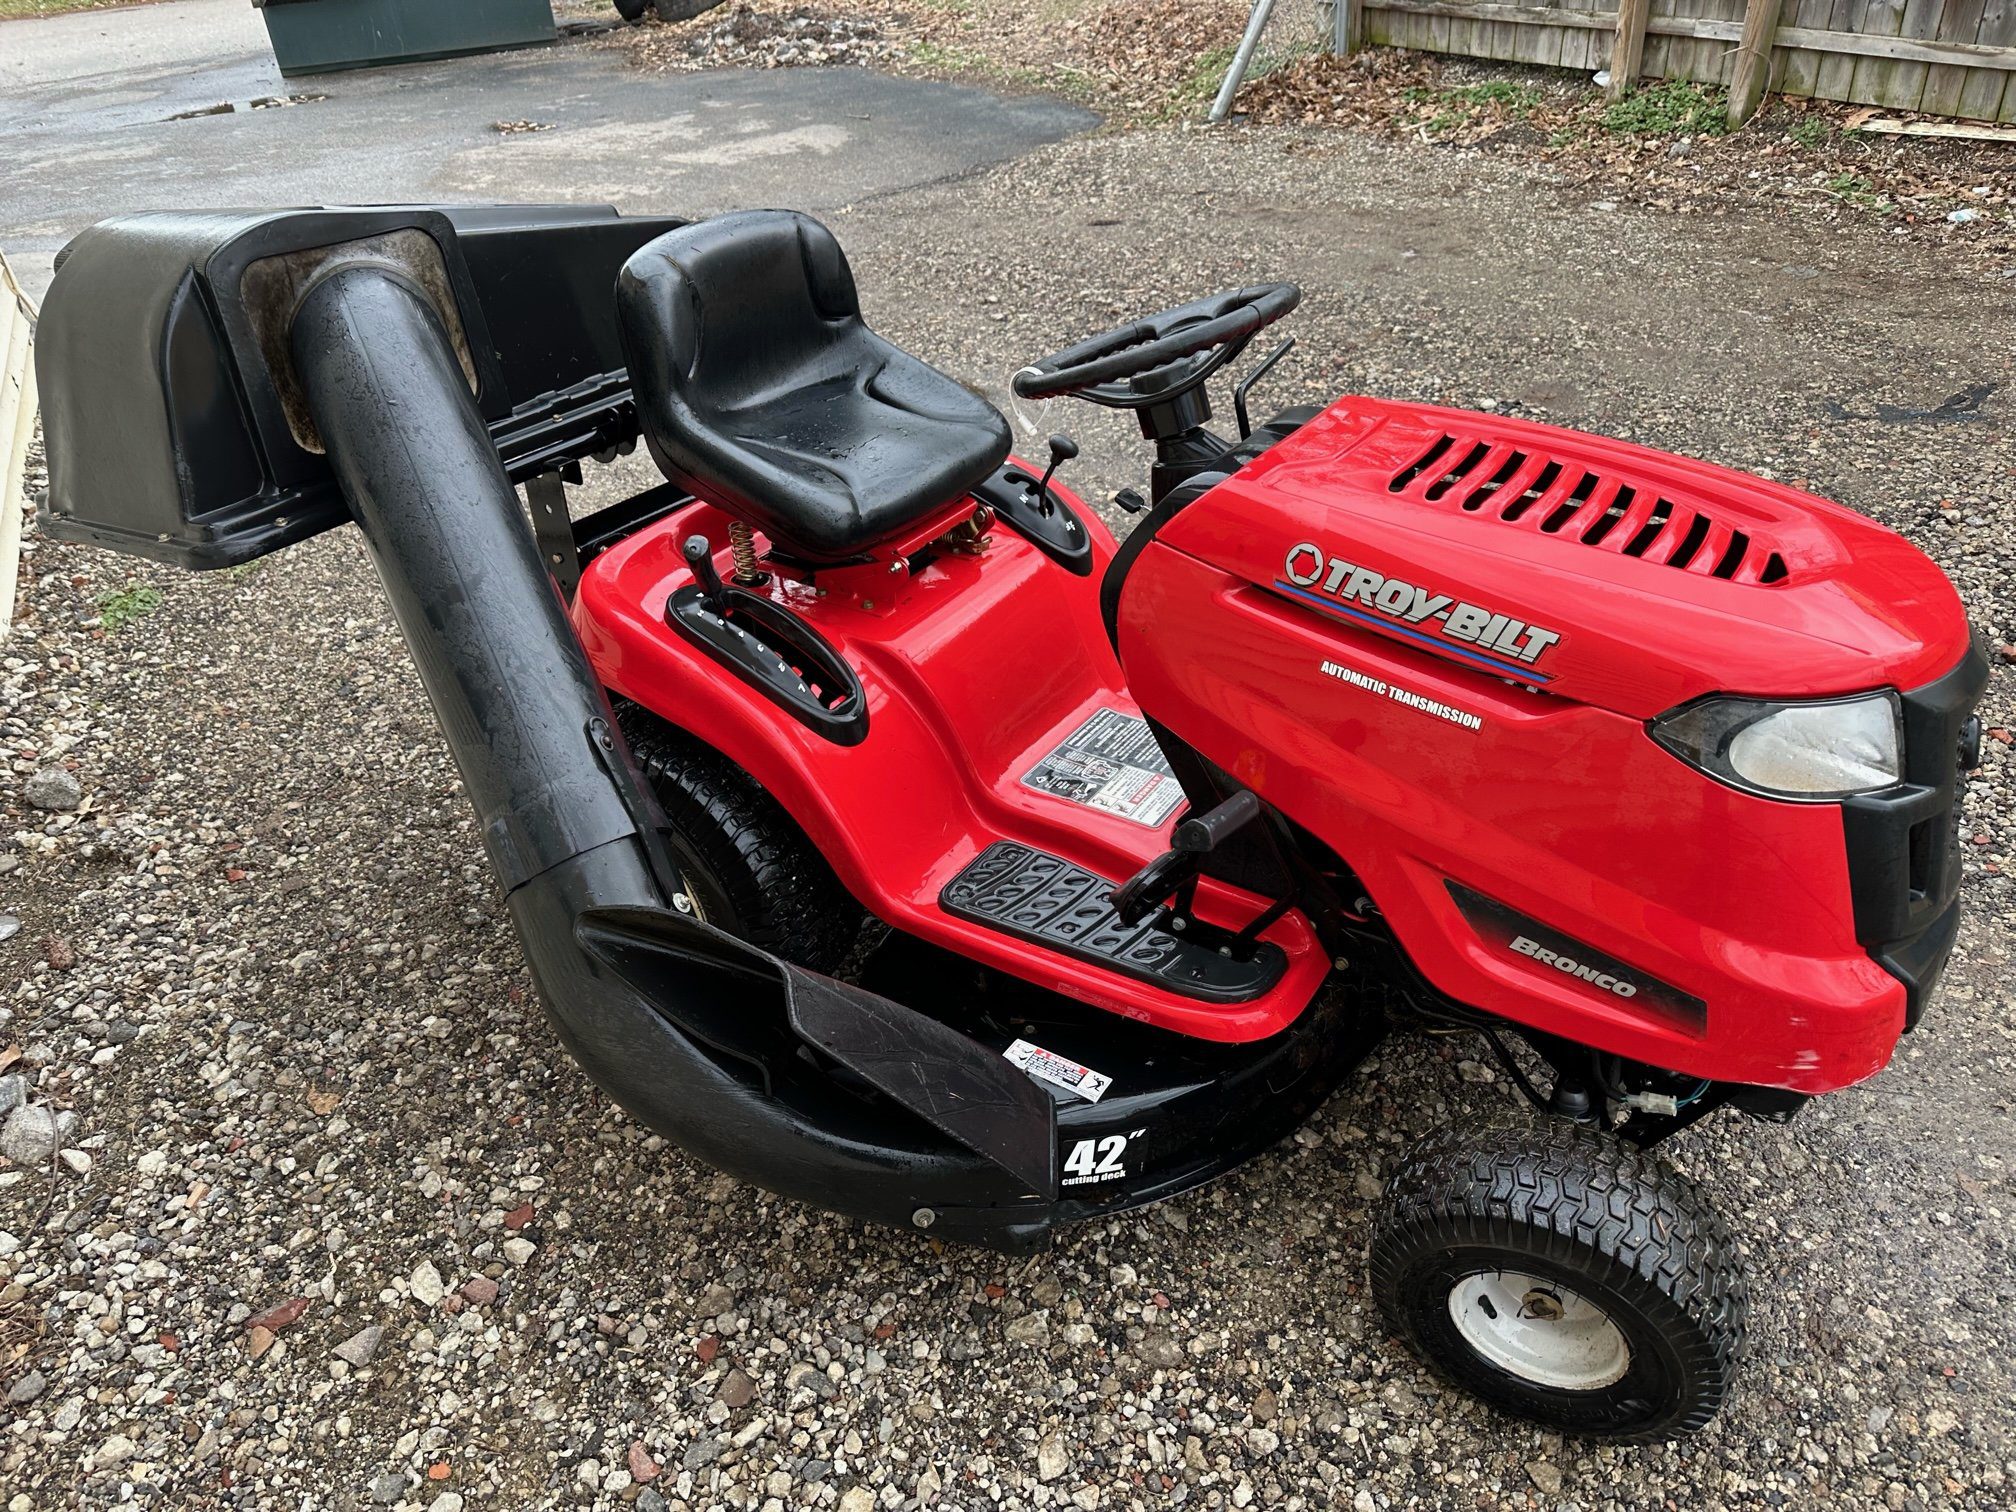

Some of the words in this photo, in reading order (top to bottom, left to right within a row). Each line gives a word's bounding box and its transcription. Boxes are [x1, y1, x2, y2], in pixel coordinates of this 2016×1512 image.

[1018, 493, 1029, 504] N
[1323, 556, 1561, 663] TROY-BILT
[778, 662, 786, 672] 2
[1320, 660, 1387, 695] AUTOMATIC
[1388, 684, 1483, 731] TRANSMISSION
[1508, 935, 1638, 998] BRONCO
[1061, 1174, 1100, 1187] cutting
[1101, 1169, 1127, 1182] deck
